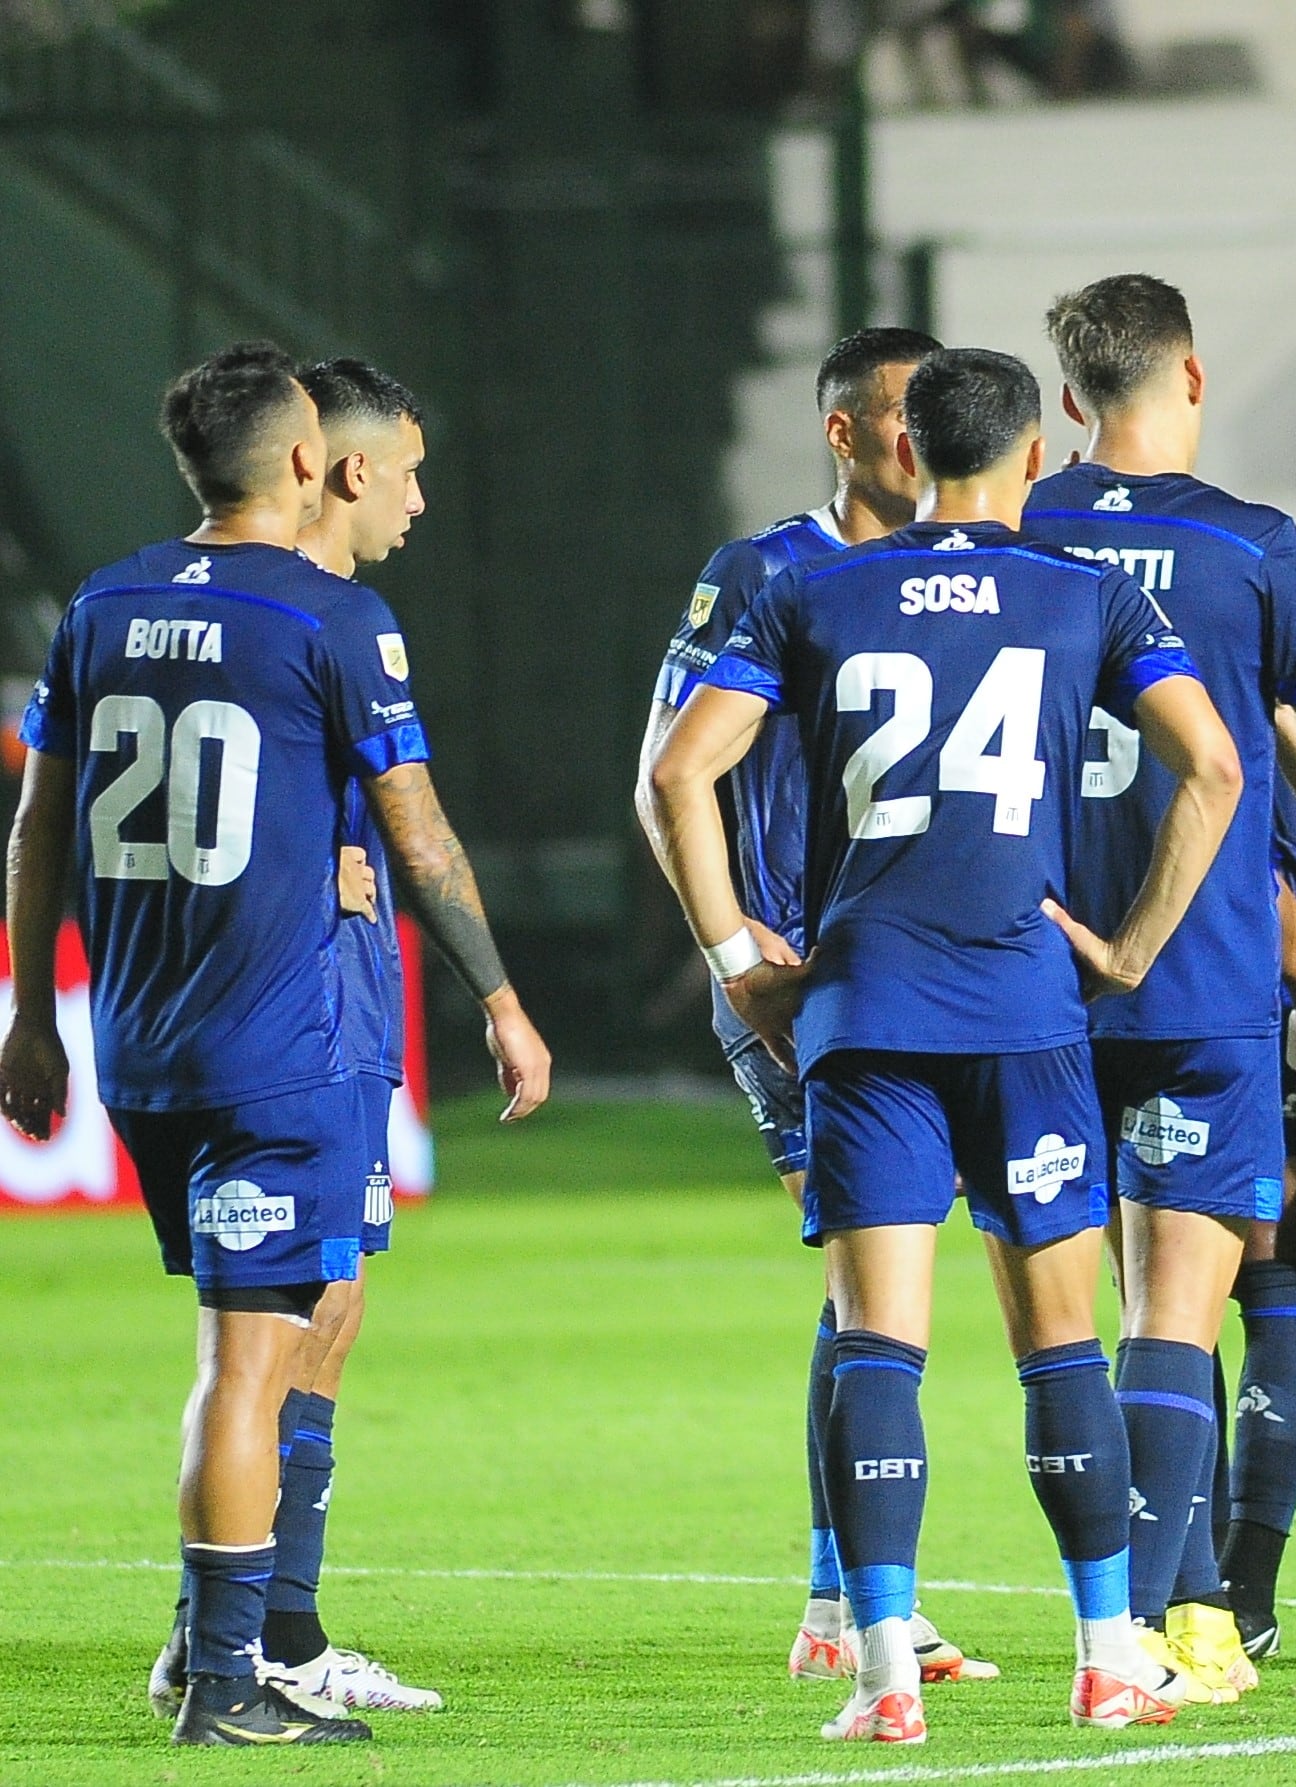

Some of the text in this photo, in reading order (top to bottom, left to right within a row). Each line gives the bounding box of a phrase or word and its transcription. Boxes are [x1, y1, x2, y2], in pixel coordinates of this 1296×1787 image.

[900, 575, 1001, 616] SOSA
[125, 618, 223, 663] BOTTA
[836, 646, 1046, 840] 24
[89, 695, 261, 887] 20
[1015, 1169, 1035, 1185] La
[217, 1205, 288, 1224] Lácteo
